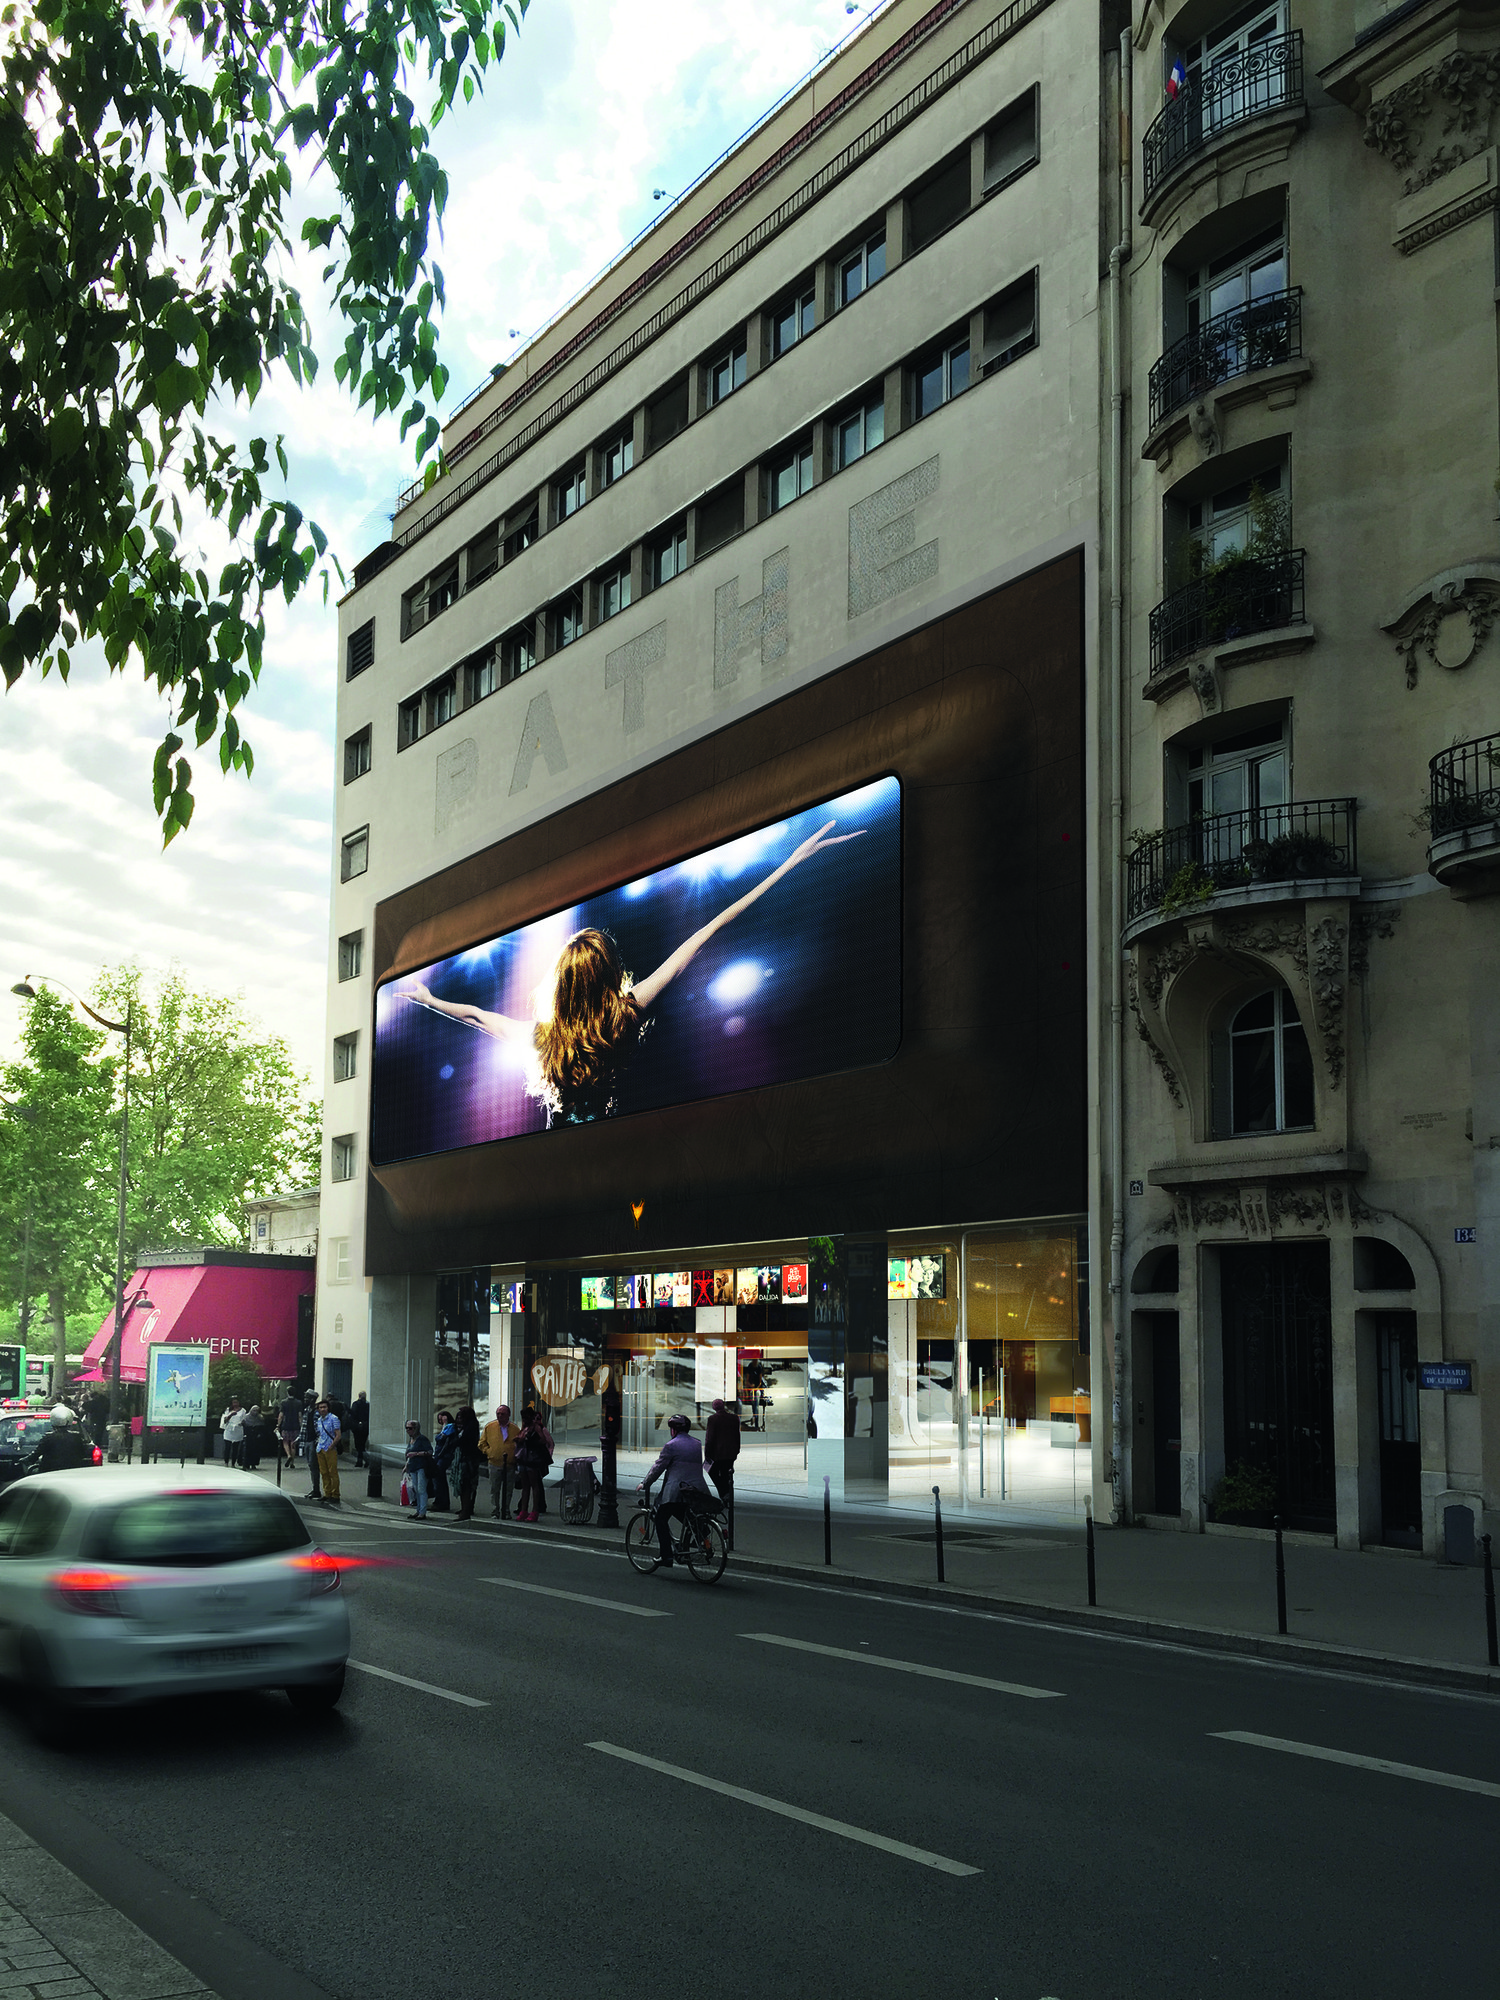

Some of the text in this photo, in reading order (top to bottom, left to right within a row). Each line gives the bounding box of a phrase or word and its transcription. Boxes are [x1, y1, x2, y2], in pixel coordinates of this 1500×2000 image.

[435, 453, 940, 835] PATHE
[1456, 1228, 1477, 1242] 134
[759, 1293, 779, 1302] DALIDA
